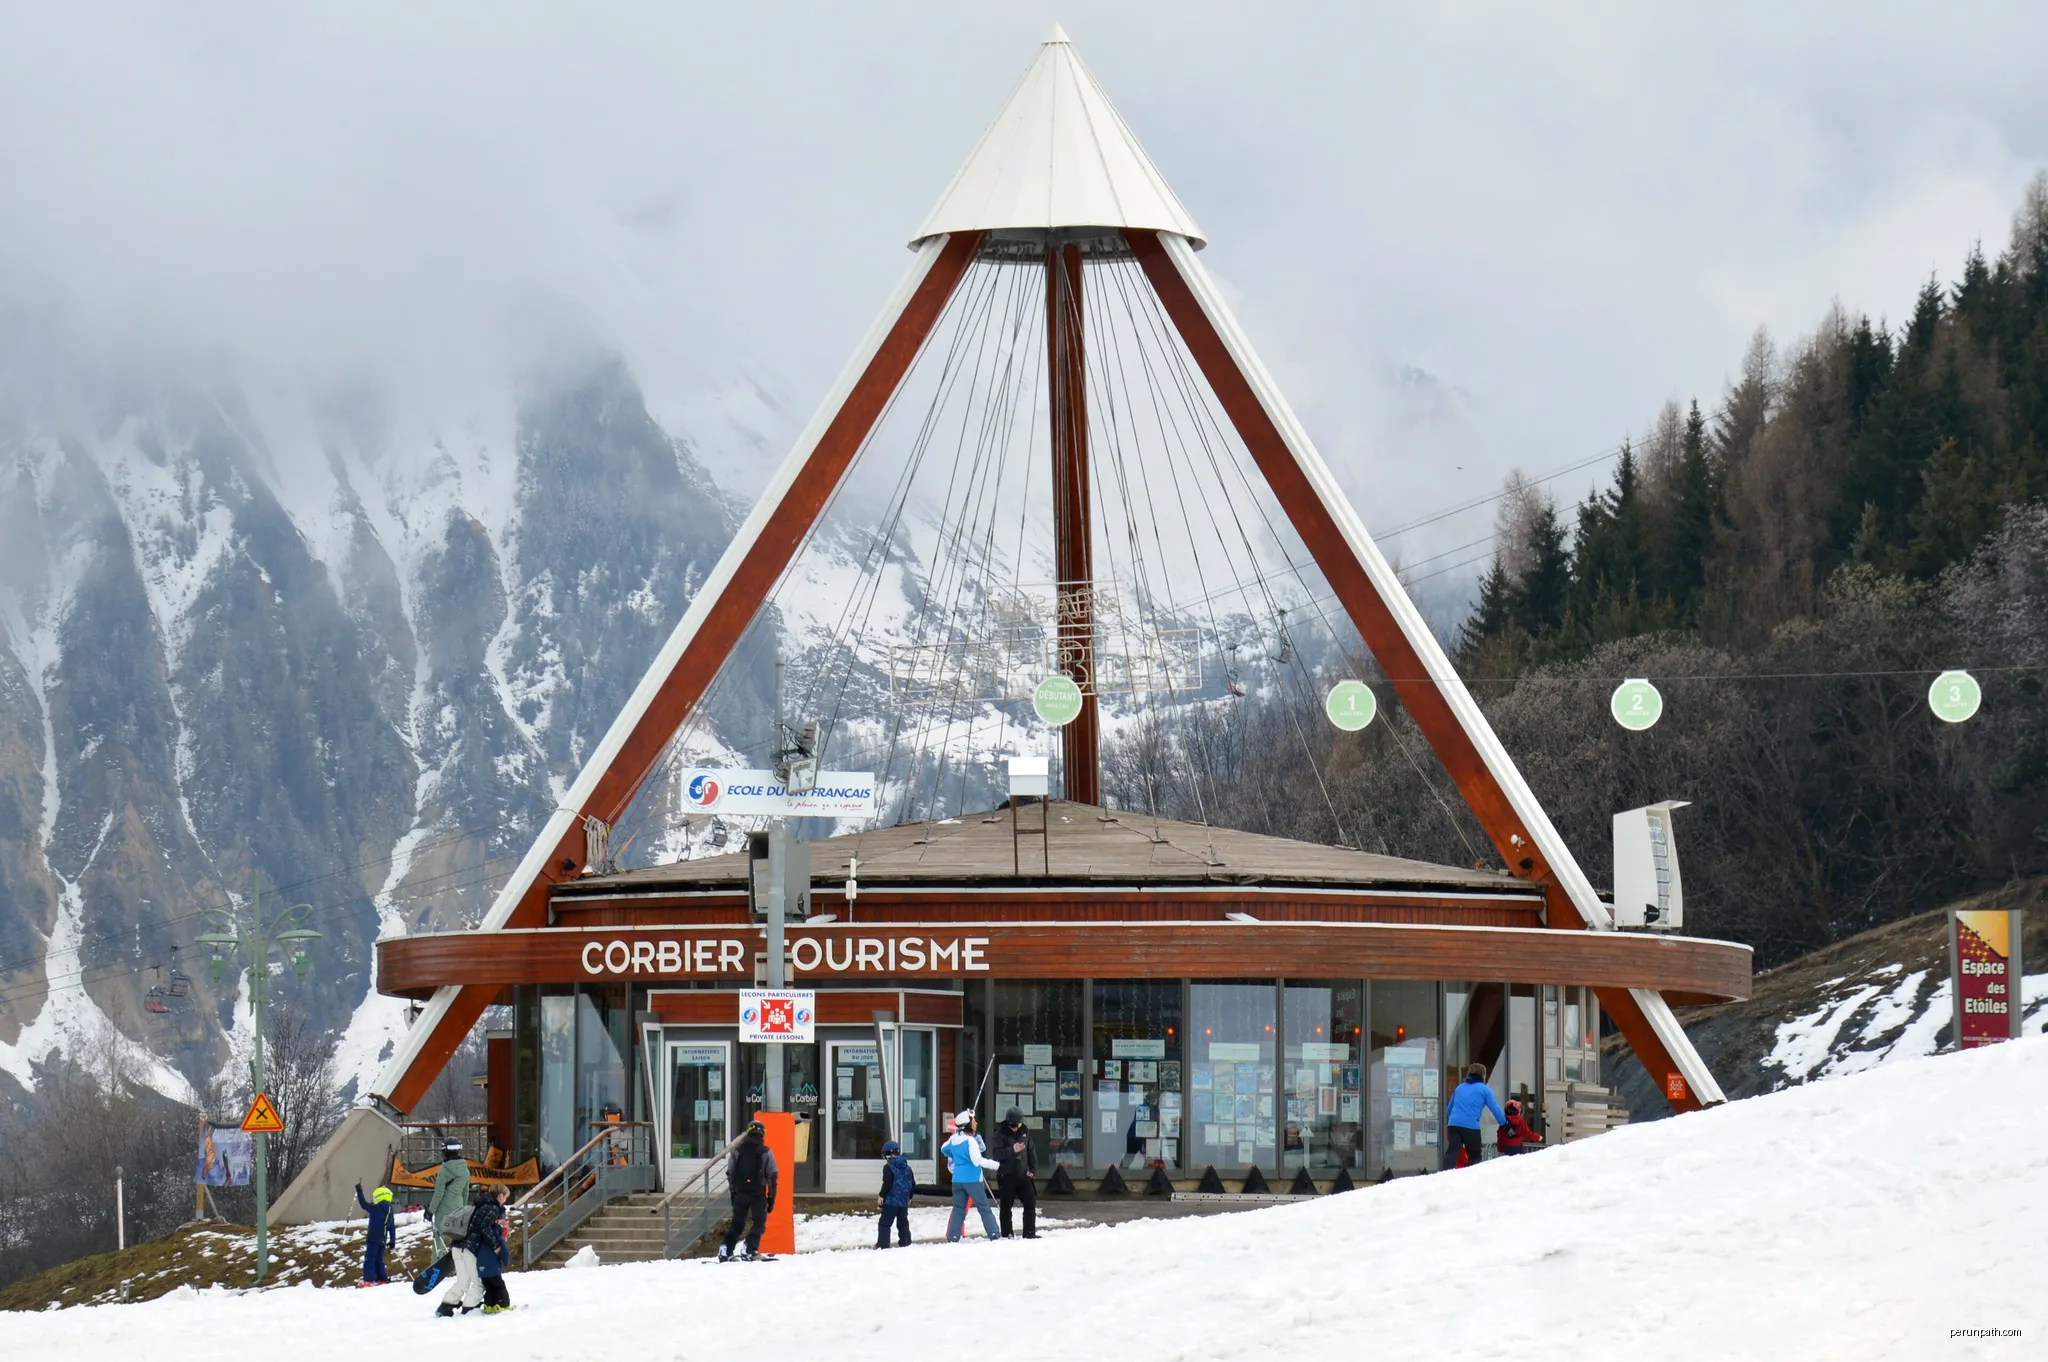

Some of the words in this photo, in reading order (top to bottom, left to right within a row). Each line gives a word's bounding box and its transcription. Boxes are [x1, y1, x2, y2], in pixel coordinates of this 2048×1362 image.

[1039, 689, 1077, 701] DÉBUTANT
[1949, 685, 1961, 702] 3
[1347, 695, 1355, 711] 1
[1632, 694, 1643, 711] 2
[727, 785, 764, 796] ECOLE
[766, 786, 786, 797] DU
[811, 787, 871, 799] FRANÇAIS
[582, 940, 745, 974] CORBIER
[783, 937, 990, 972] OURISME
[1962, 959, 2005, 977] Espace
[1987, 982, 2006, 994] des
[1965, 998, 2008, 1014] Etoiles
[795, 1093, 818, 1103] Corbier
